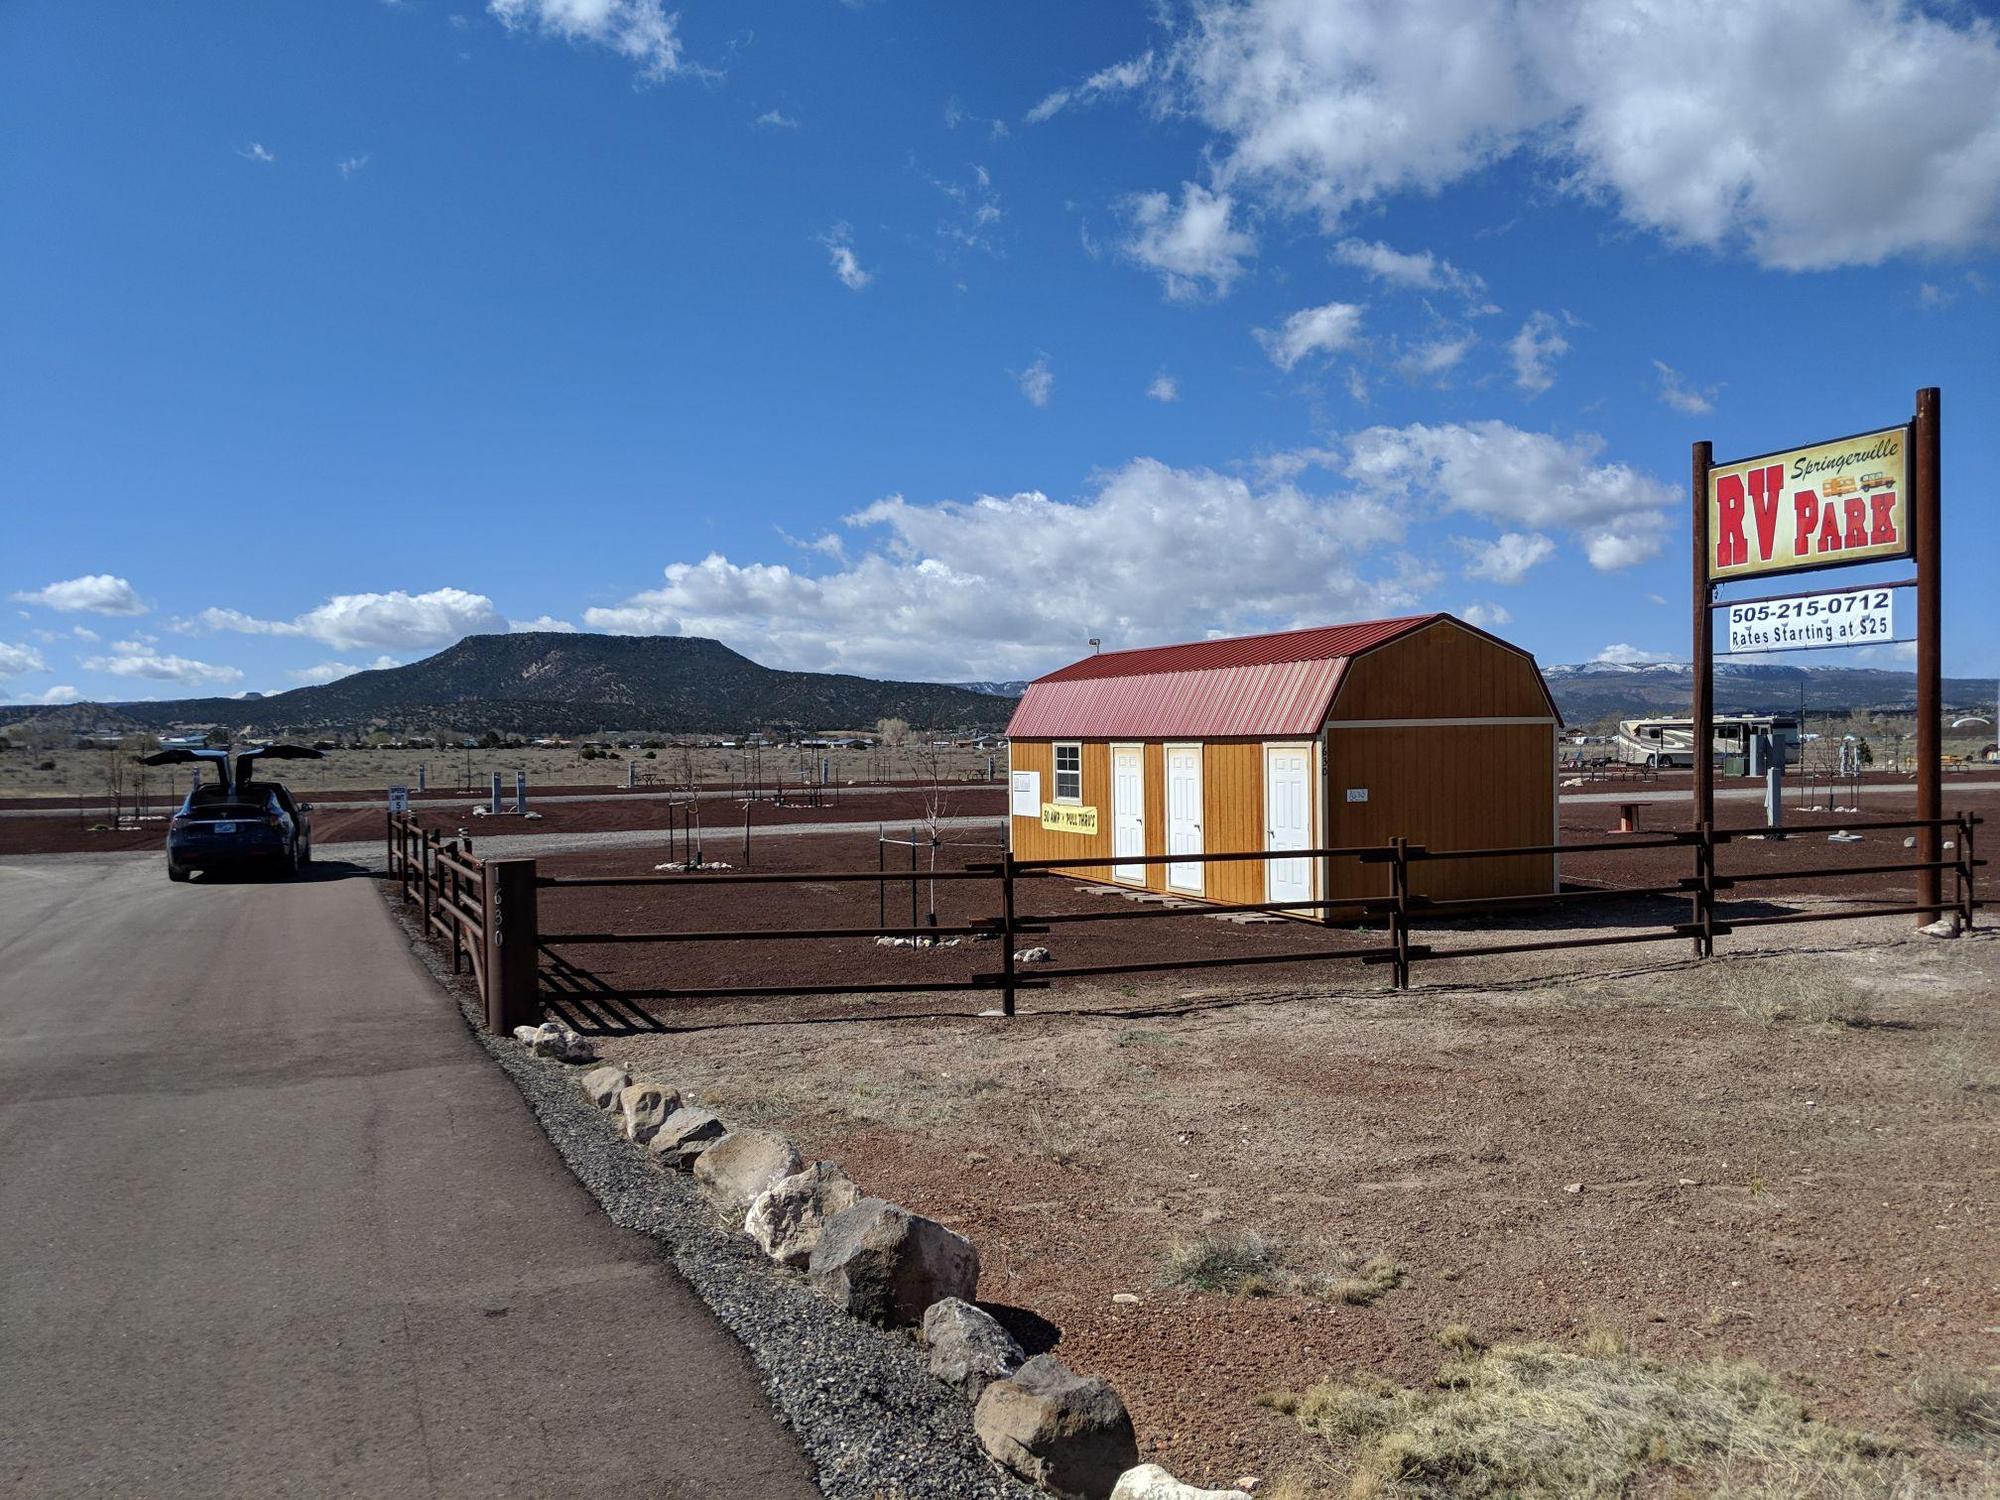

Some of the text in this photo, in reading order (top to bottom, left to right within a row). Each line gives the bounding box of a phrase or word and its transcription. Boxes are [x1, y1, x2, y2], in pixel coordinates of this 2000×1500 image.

[1791, 438, 1898, 480] Springerville
[1716, 463, 1897, 568] RV PARK
[1732, 592, 1889, 624] 505-215-0712
[1732, 616, 1887, 646] Rates Starting at $25
